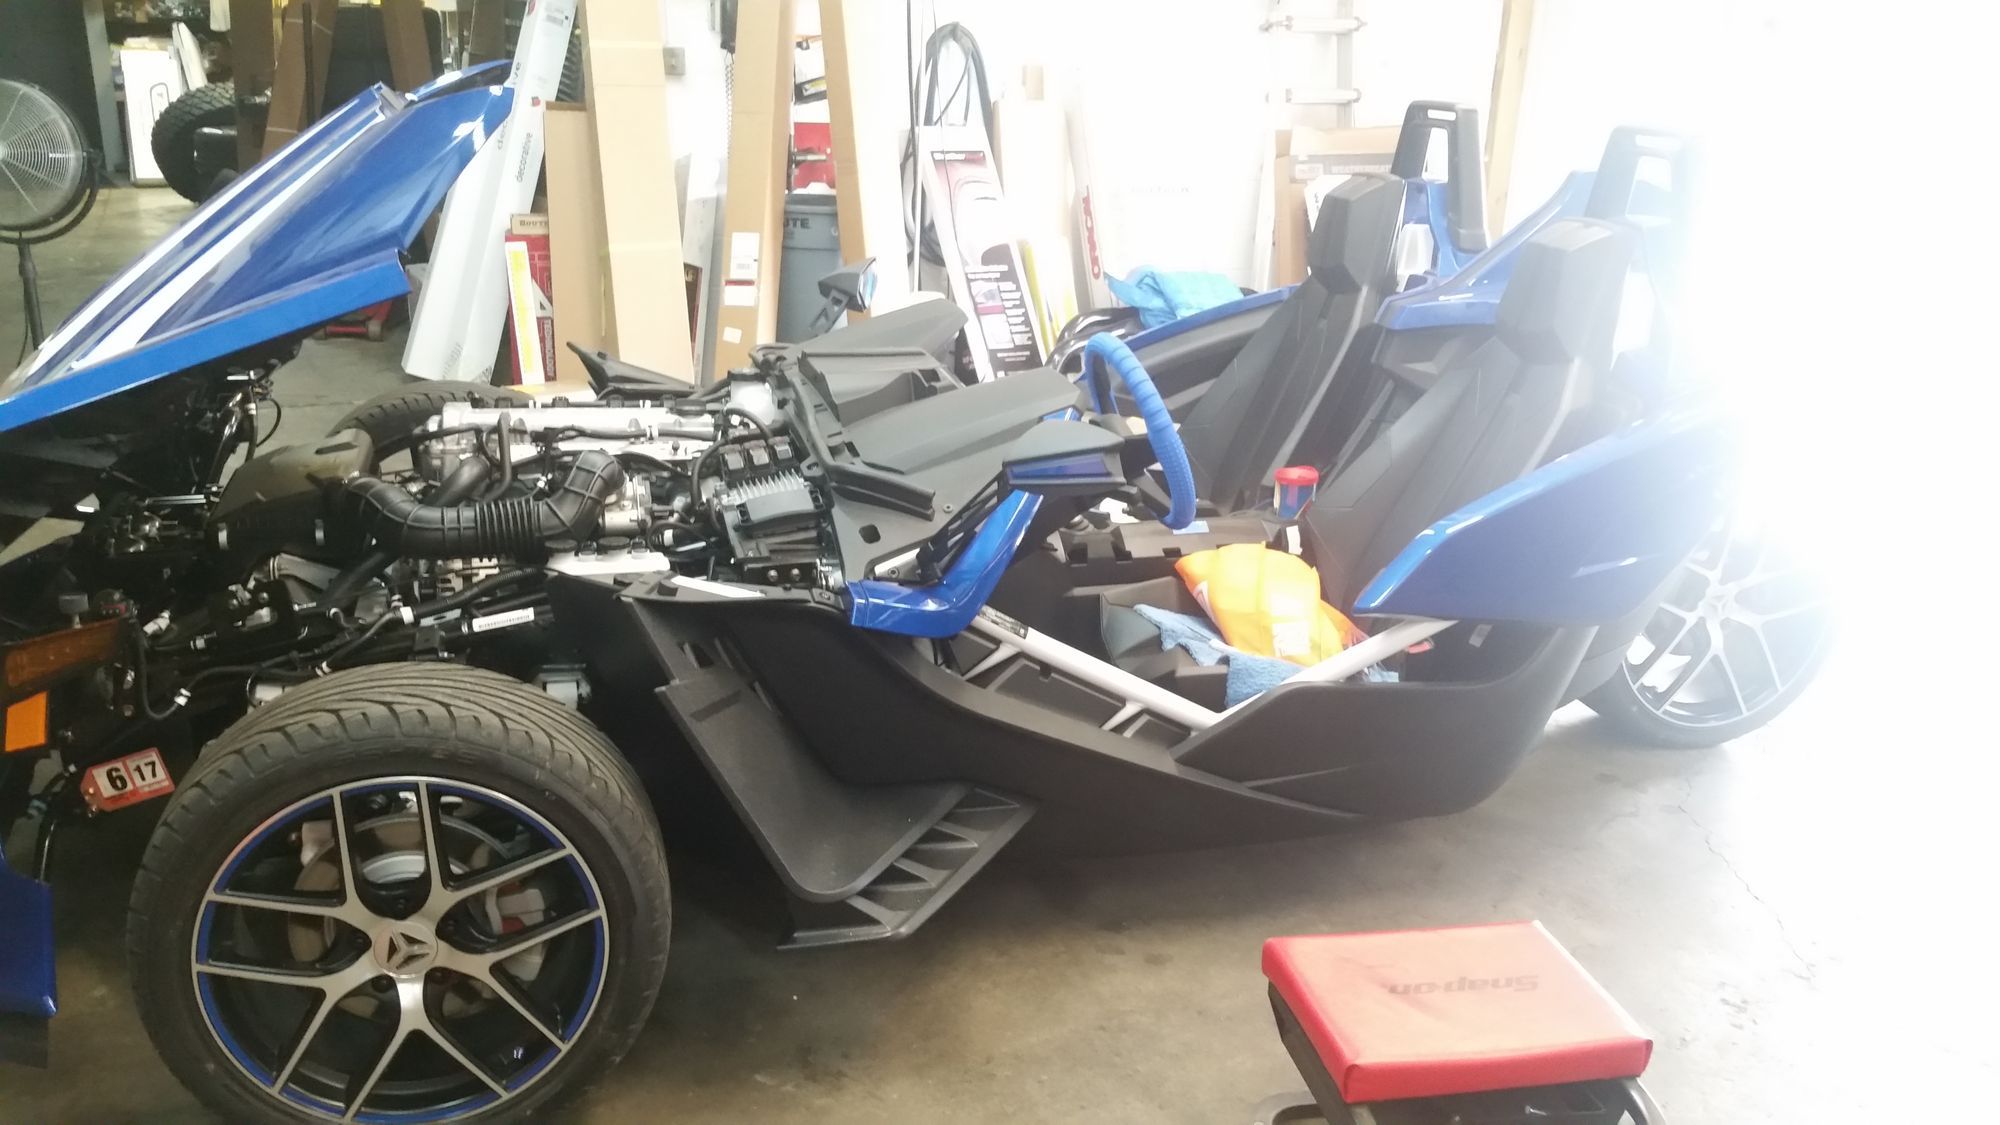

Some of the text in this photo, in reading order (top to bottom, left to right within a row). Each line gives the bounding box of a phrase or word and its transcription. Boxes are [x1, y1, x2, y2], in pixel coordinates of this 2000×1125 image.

[515, 132, 533, 183] decorative
[106, 766, 128, 792] 6
[133, 760, 158, 782] 17
